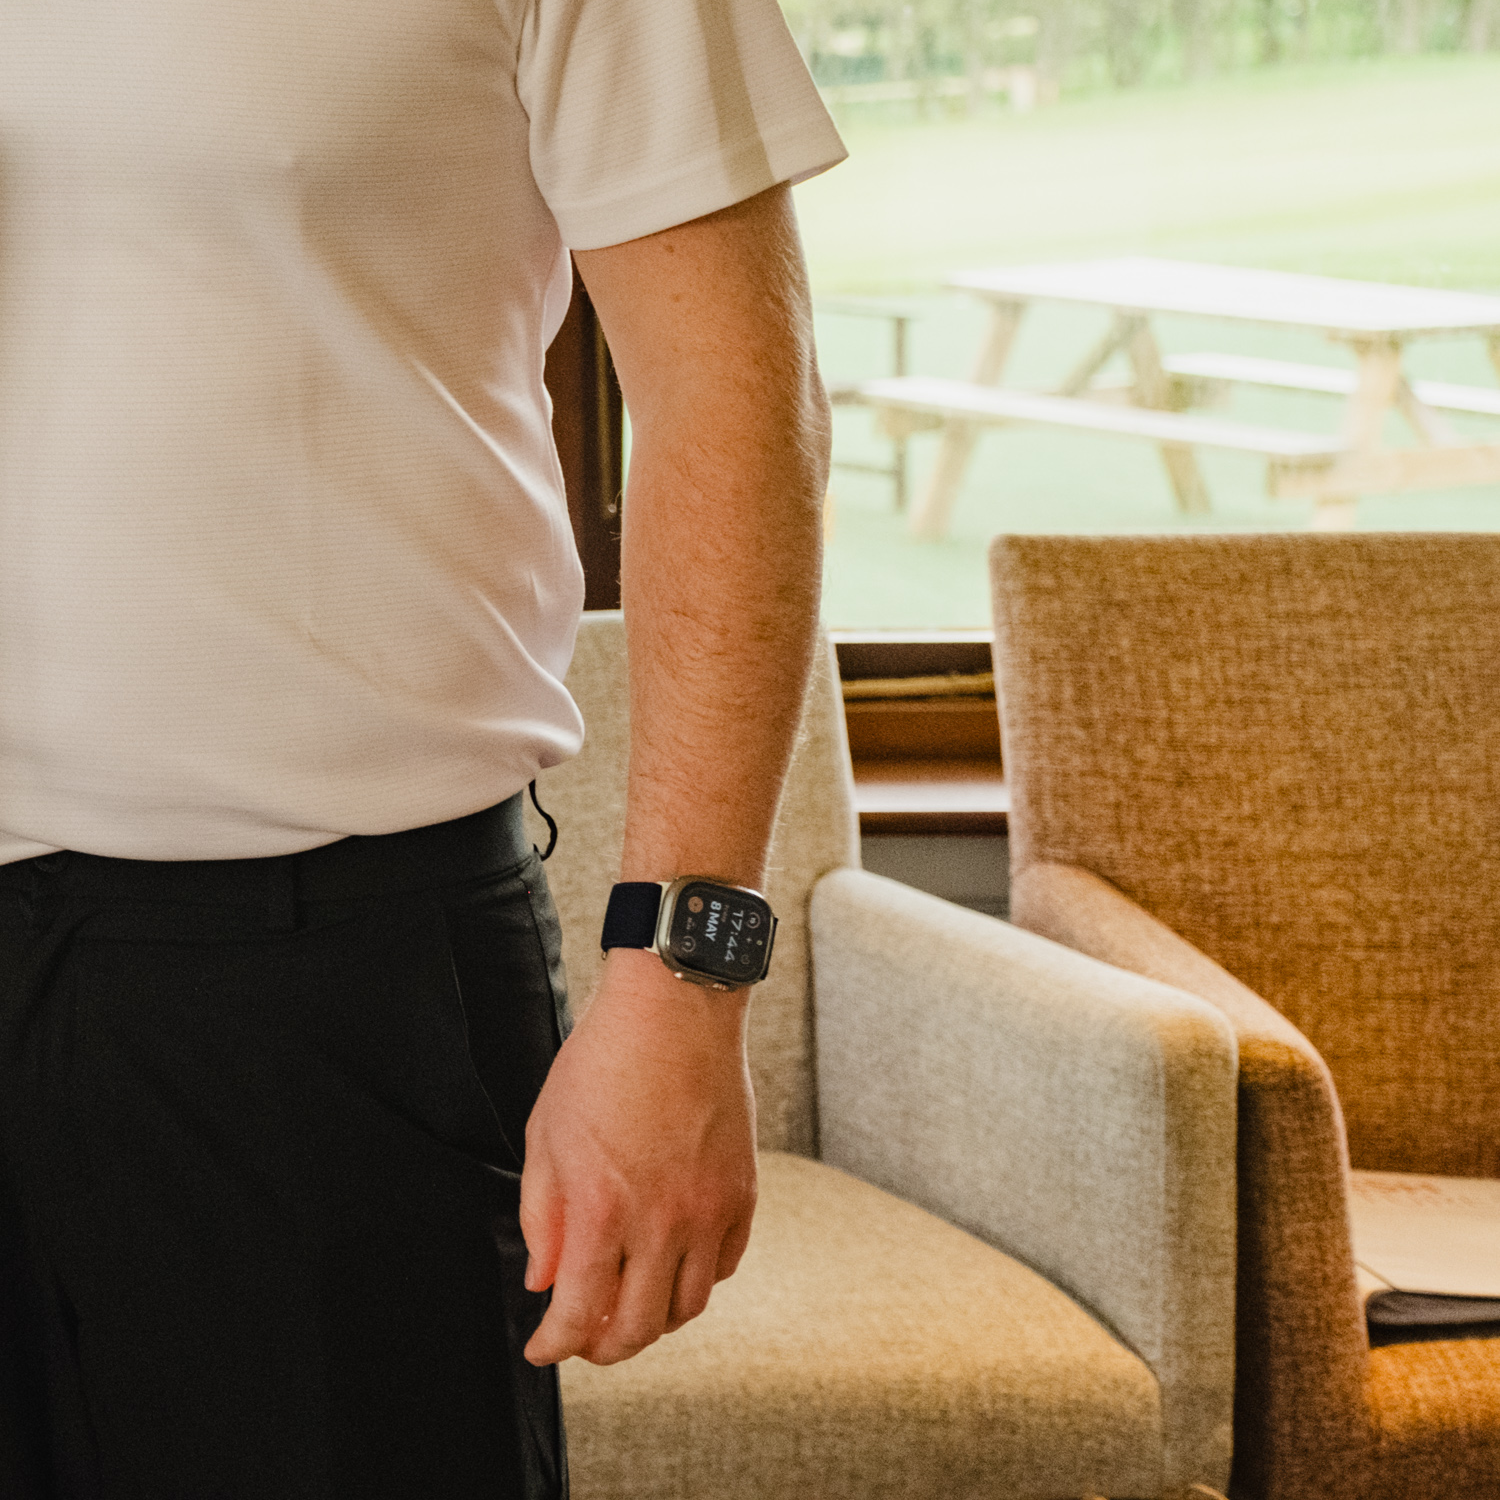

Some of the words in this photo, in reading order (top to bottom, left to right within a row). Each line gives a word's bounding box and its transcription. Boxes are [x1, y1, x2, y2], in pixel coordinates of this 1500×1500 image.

[710, 900, 722, 911] 8
[705, 911, 721, 942] MAY
[724, 910, 744, 962] 17:44
